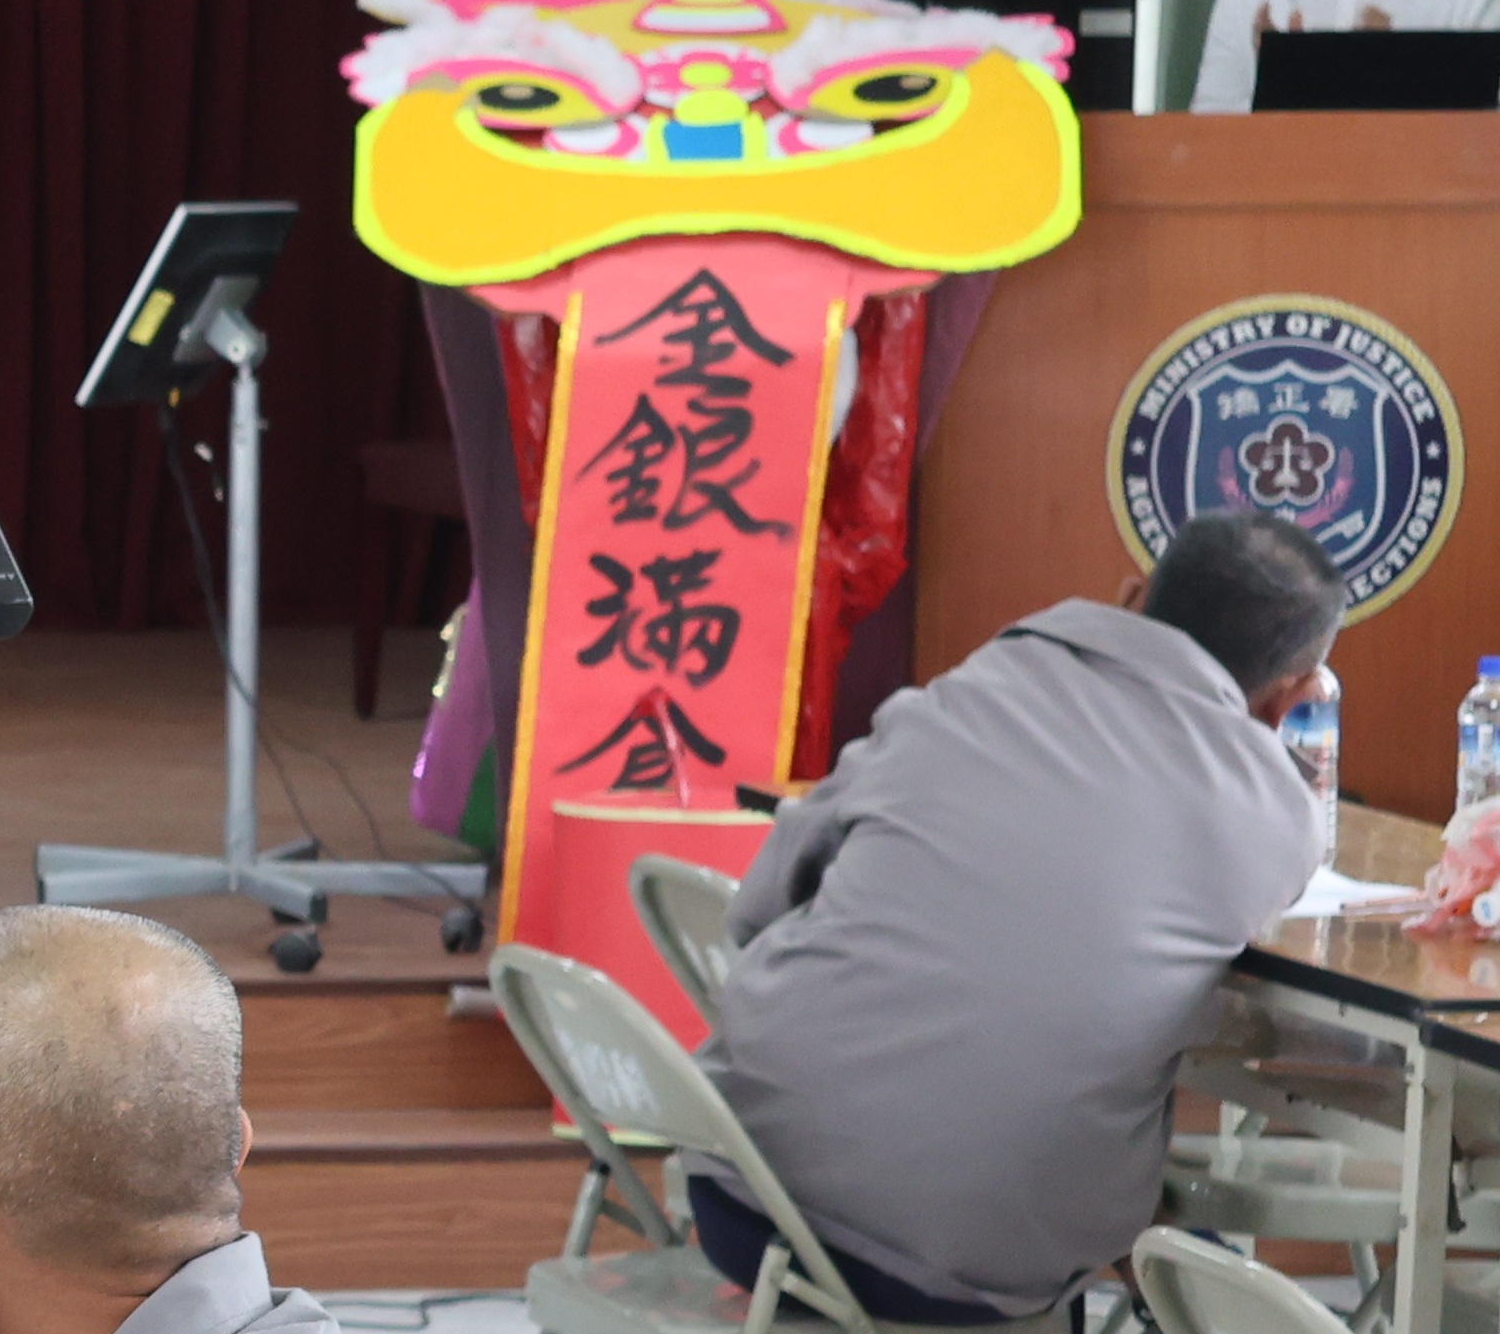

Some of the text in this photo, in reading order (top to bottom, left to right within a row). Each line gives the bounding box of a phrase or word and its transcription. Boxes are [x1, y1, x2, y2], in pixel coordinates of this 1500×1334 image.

[1139, 312, 1437, 424] MINISTRY OF JUSTICE
[1347, 476, 1443, 604] ECTIONS
